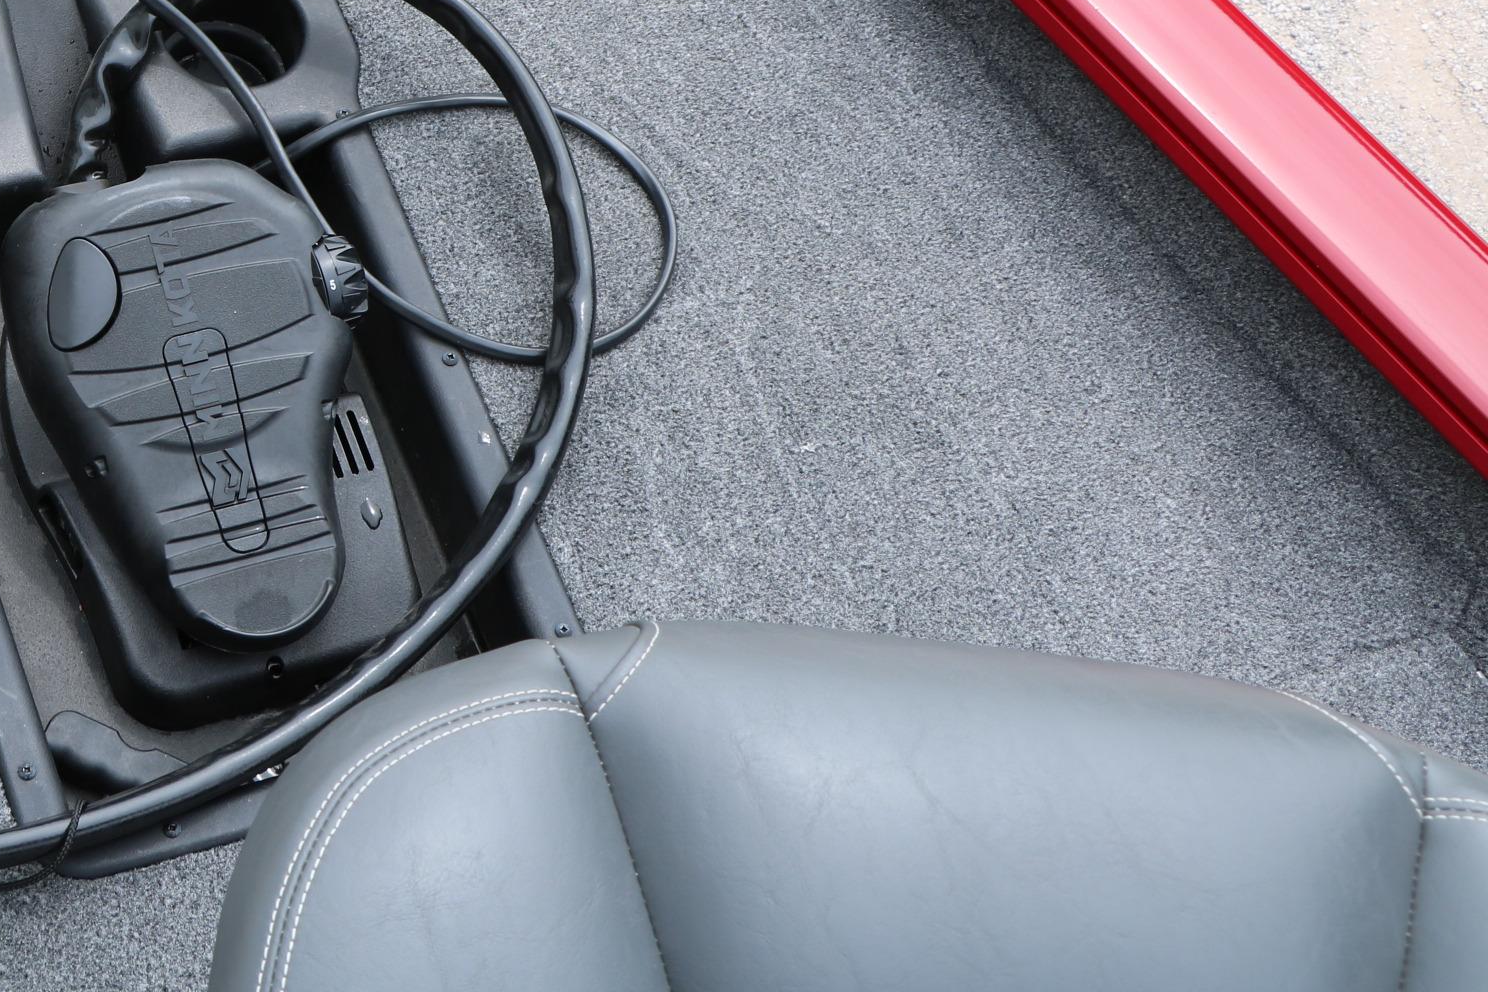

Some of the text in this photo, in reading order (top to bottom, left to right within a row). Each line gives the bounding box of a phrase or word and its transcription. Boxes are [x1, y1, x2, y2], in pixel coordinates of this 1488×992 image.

[147, 225, 230, 442] MINN KOTA
[329, 279, 337, 291] 5
